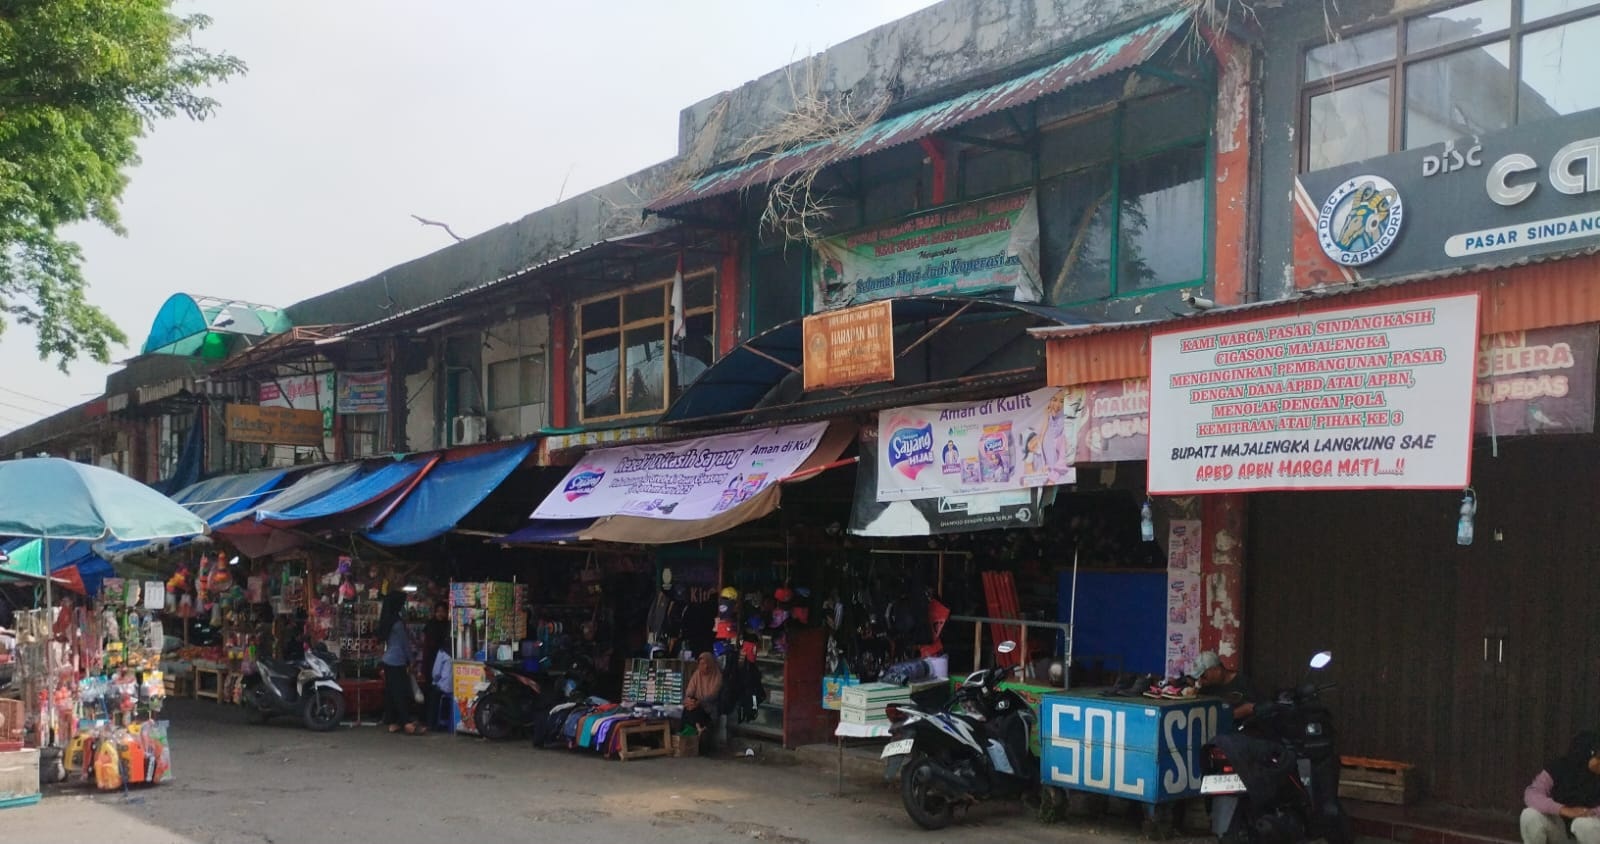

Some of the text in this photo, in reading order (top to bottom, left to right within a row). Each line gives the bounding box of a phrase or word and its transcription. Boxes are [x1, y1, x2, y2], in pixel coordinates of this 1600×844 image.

[1319, 195, 1338, 229] DISC
[1341, 205, 1401, 263] CAPRICORN
[1465, 231, 1518, 250] PASAR
[1181, 308, 1435, 352] KAMI WARGA PASAR SINDANGKASIH
[1214, 334, 1389, 365] CIGASONG MAJALENGKA
[1479, 343, 1573, 377] SELERA
[1170, 348, 1446, 388] MENGINGINKAN PEMBANGUNAN PASAR
[1190, 370, 1415, 403] DENGAN DANA APBD ATAU APBN,
[1494, 375, 1568, 401] PEDAS
[940, 393, 1032, 422] Aman di Kulit
[1212, 391, 1386, 418] MENOLAK DENGAN POLA
[1197, 410, 1403, 437] KEMITRAAN ATAU PIHAK KE 3
[750, 438, 816, 456] Aman di Kul
[892, 428, 932, 460] Sayang
[1171, 434, 1437, 460] BUPATI MAJALENGKA LANGKUNG SAE
[694, 449, 743, 472] Sayang
[1196, 465, 1233, 481] APBD
[1238, 461, 1274, 479] APBN
[1277, 459, 1333, 478] HARGA
[1051, 703, 1145, 796] SOL
